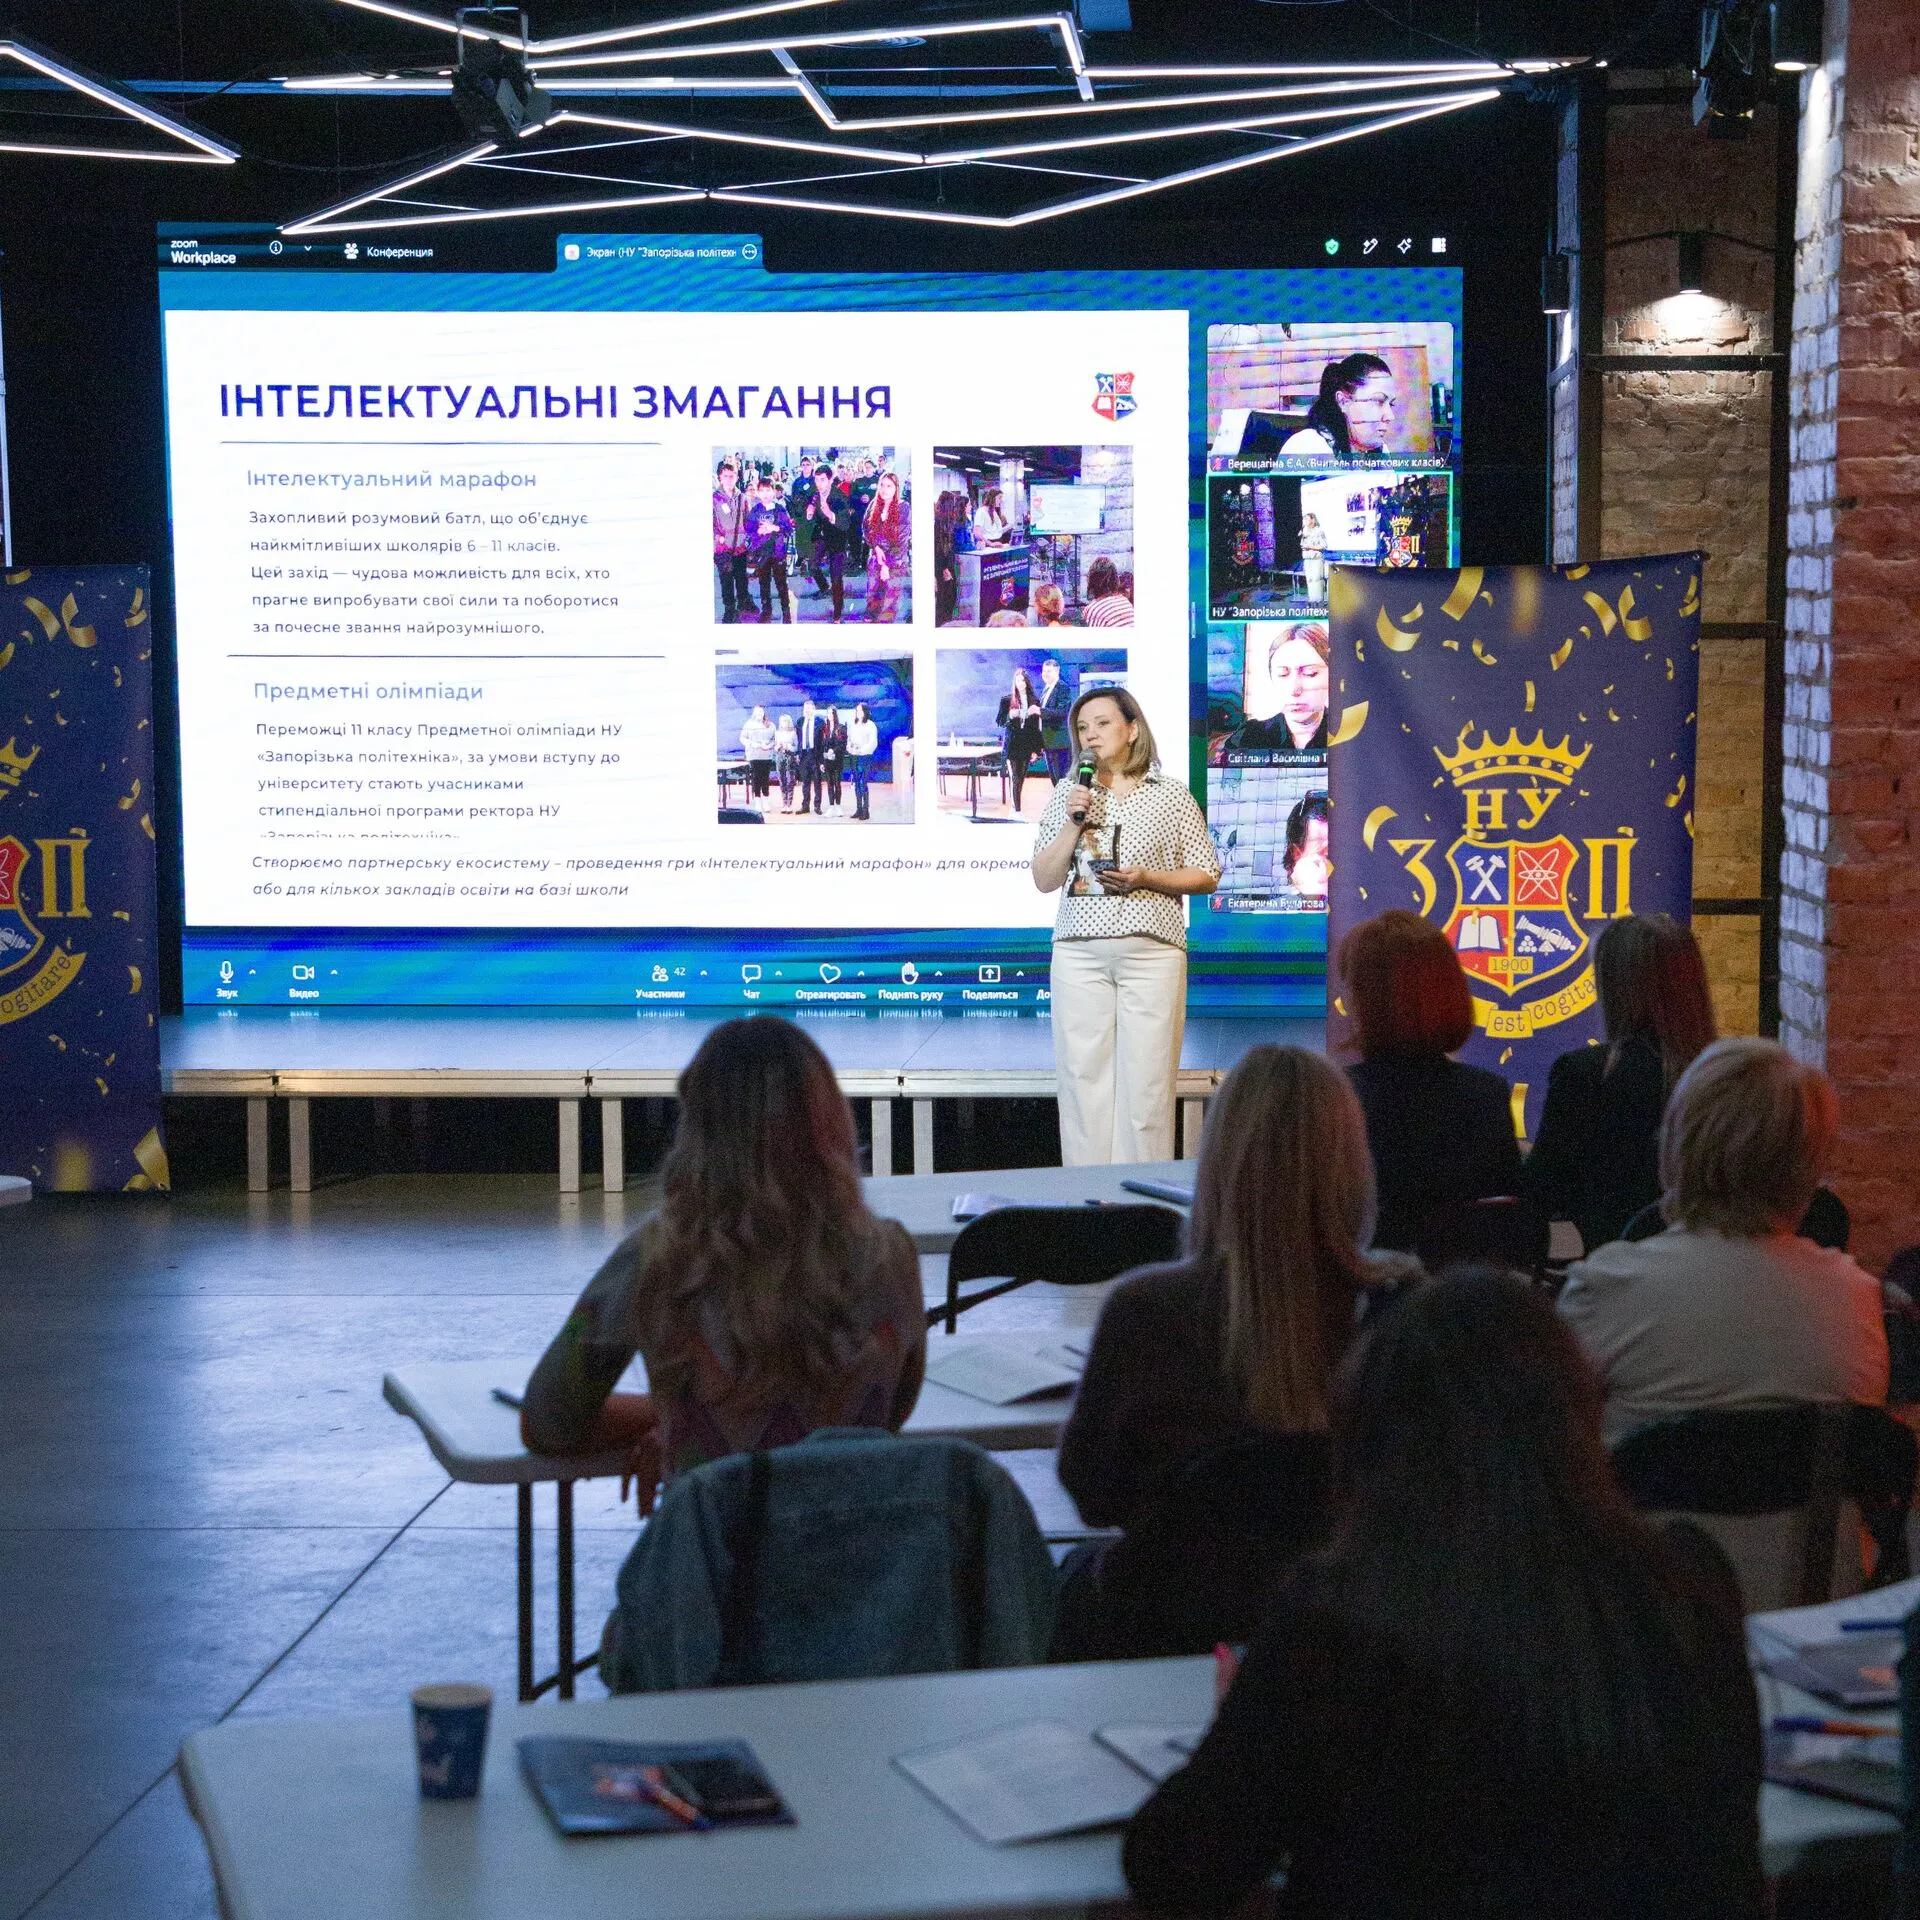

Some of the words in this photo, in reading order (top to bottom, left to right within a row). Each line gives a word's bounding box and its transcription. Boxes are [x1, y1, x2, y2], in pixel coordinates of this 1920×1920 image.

[171, 252, 236, 265] Workplace
[367, 248, 433, 258] Конференция
[587, 247, 615, 258] Экран
[619, 247, 635, 258] (НУ
[221, 385, 616, 418] ІНТЕЛЕКТУАЛЬНІ
[633, 385, 890, 418] ЗМАГАННЯ
[248, 471, 431, 490] Інтелектуальний
[441, 472, 536, 490] марафон
[250, 511, 346, 523] Захопливий
[352, 512, 440, 526] розумовий
[446, 512, 485, 525] батл,
[491, 515, 513, 525] що
[251, 538, 381, 551] найкмітливіших
[387, 539, 462, 554] школярів
[468, 540, 475, 552] 6
[492, 540, 501, 551] 11
[508, 539, 561, 552] класів.
[252, 567, 282, 580] Цей
[289, 566, 328, 579] захід
[353, 570, 407, 581] чудова
[414, 567, 506, 579] можливість
[512, 570, 540, 580] для
[546, 567, 579, 580] всіх,
[586, 570, 609, 579] хто
[253, 596, 308, 608] прагне
[314, 594, 417, 608] випробувати
[423, 594, 453, 606] свої
[460, 597, 497, 606] сили
[503, 597, 518, 606] та
[525, 594, 618, 609] поборотися
[1213, 607, 1226, 617] НУ
[254, 624, 269, 632] за
[275, 624, 340, 632] почесне
[347, 624, 400, 633] звання
[407, 622, 544, 636] найрозумнішого.
[255, 682, 368, 702] Предметні
[377, 682, 482, 701] олімпіади
[257, 723, 345, 737] Переможці
[352, 724, 361, 735] 11
[368, 727, 412, 738] класу
[418, 724, 511, 738] Предметної
[517, 723, 595, 737] олімпіади
[602, 725, 622, 736] НУ
[258, 750, 352, 764] «Запорізька
[359, 750, 462, 764] політехніка»,
[468, 754, 483, 762] за
[489, 754, 537, 766] умови
[544, 754, 595, 765] вступу
[601, 754, 619, 764] до
[259, 777, 362, 792] університету
[369, 781, 422, 789] стають
[428, 781, 523, 792] учасниками
[259, 804, 380, 817] стипендіальної
[387, 808, 463, 819] програми
[470, 808, 533, 819] ректора
[540, 806, 560, 816] НУ
[1462, 789, 1562, 829] НУ
[253, 857, 342, 870] Створюємо
[348, 860, 451, 871] партнерську
[457, 860, 550, 871] екосистему
[567, 860, 662, 871] проведення
[668, 859, 695, 871] гри
[700, 858, 844, 872] «Інтелектуальний
[850, 858, 931, 871] марафон»
[936, 861, 965, 870] для
[970, 859, 1032, 872] окремо
[34, 839, 92, 918] П
[1583, 838, 1639, 919] П
[253, 883, 281, 895] або
[286, 886, 315, 896] для
[321, 883, 379, 895] кількох
[385, 883, 455, 896] закладів
[460, 883, 509, 895] освіти
[515, 887, 534, 895] на
[540, 883, 571, 895] базі
[576, 887, 628, 895] школи
[674, 967, 686, 976] 42
[1491, 958, 1530, 972] 1900
[216, 988, 238, 999] Звук
[289, 988, 319, 998] Видео
[636, 989, 685, 1000] Участники
[744, 990, 760, 999] Чат
[795, 990, 866, 1001] Отреагировать
[878, 990, 918, 1001] Поднять
[920, 992, 943, 1001] руку
[963, 990, 1018, 1001] Поделиться
[1494, 1014, 1525, 1033] est
[1534, 971, 1597, 1021] cogita
